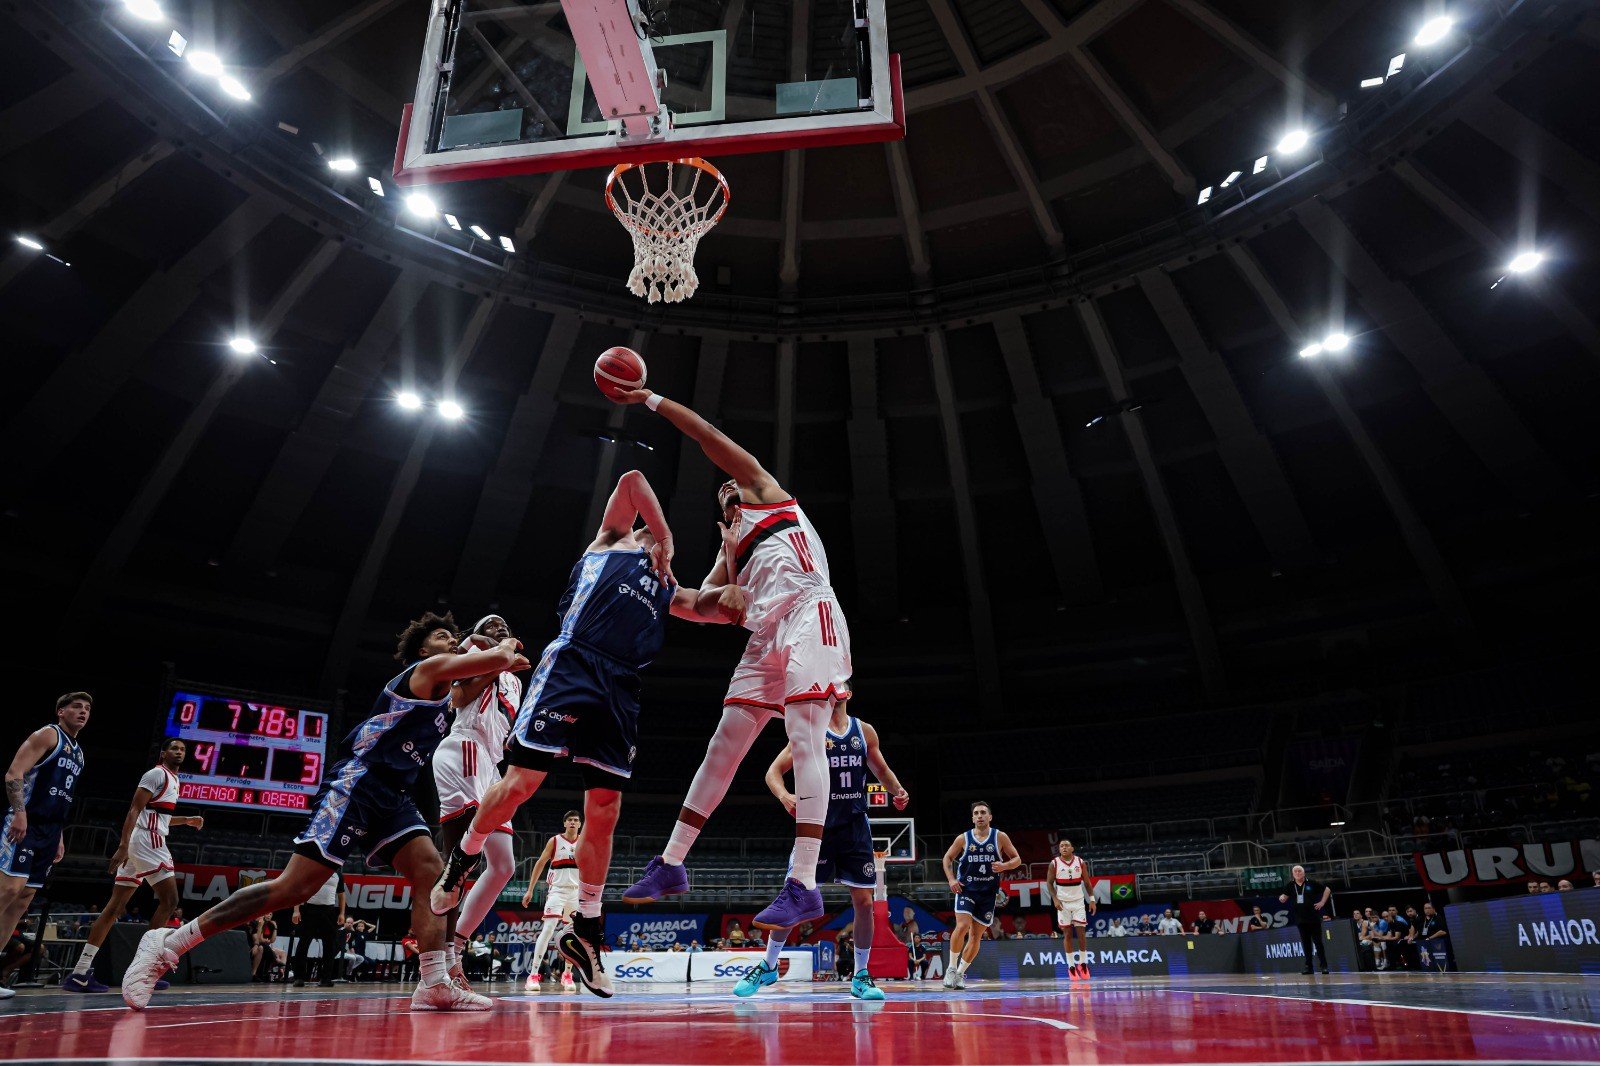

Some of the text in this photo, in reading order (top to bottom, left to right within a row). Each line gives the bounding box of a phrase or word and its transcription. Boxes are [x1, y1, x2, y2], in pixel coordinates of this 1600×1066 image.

[639, 575, 660, 597] 41
[181, 703, 194, 722] 0
[315, 718, 321, 735] 1
[194, 744, 214, 771] 4
[828, 755, 863, 768] BERA
[301, 754, 319, 784] 3
[65, 774, 74, 790] 8
[839, 771, 852, 788] 11
[967, 854, 996, 863] OBERA
[979, 864, 988, 875] 4
[496, 922, 508, 932] O
[629, 919, 698, 934] O MARACA
[1517, 923, 1530, 947] A
[1022, 952, 1036, 965] A
[1100, 949, 1163, 963] MARCA
[1266, 944, 1271, 959] A
[1271, 942, 1294, 958] MAIOR
[614, 964, 654, 978] Sesc
